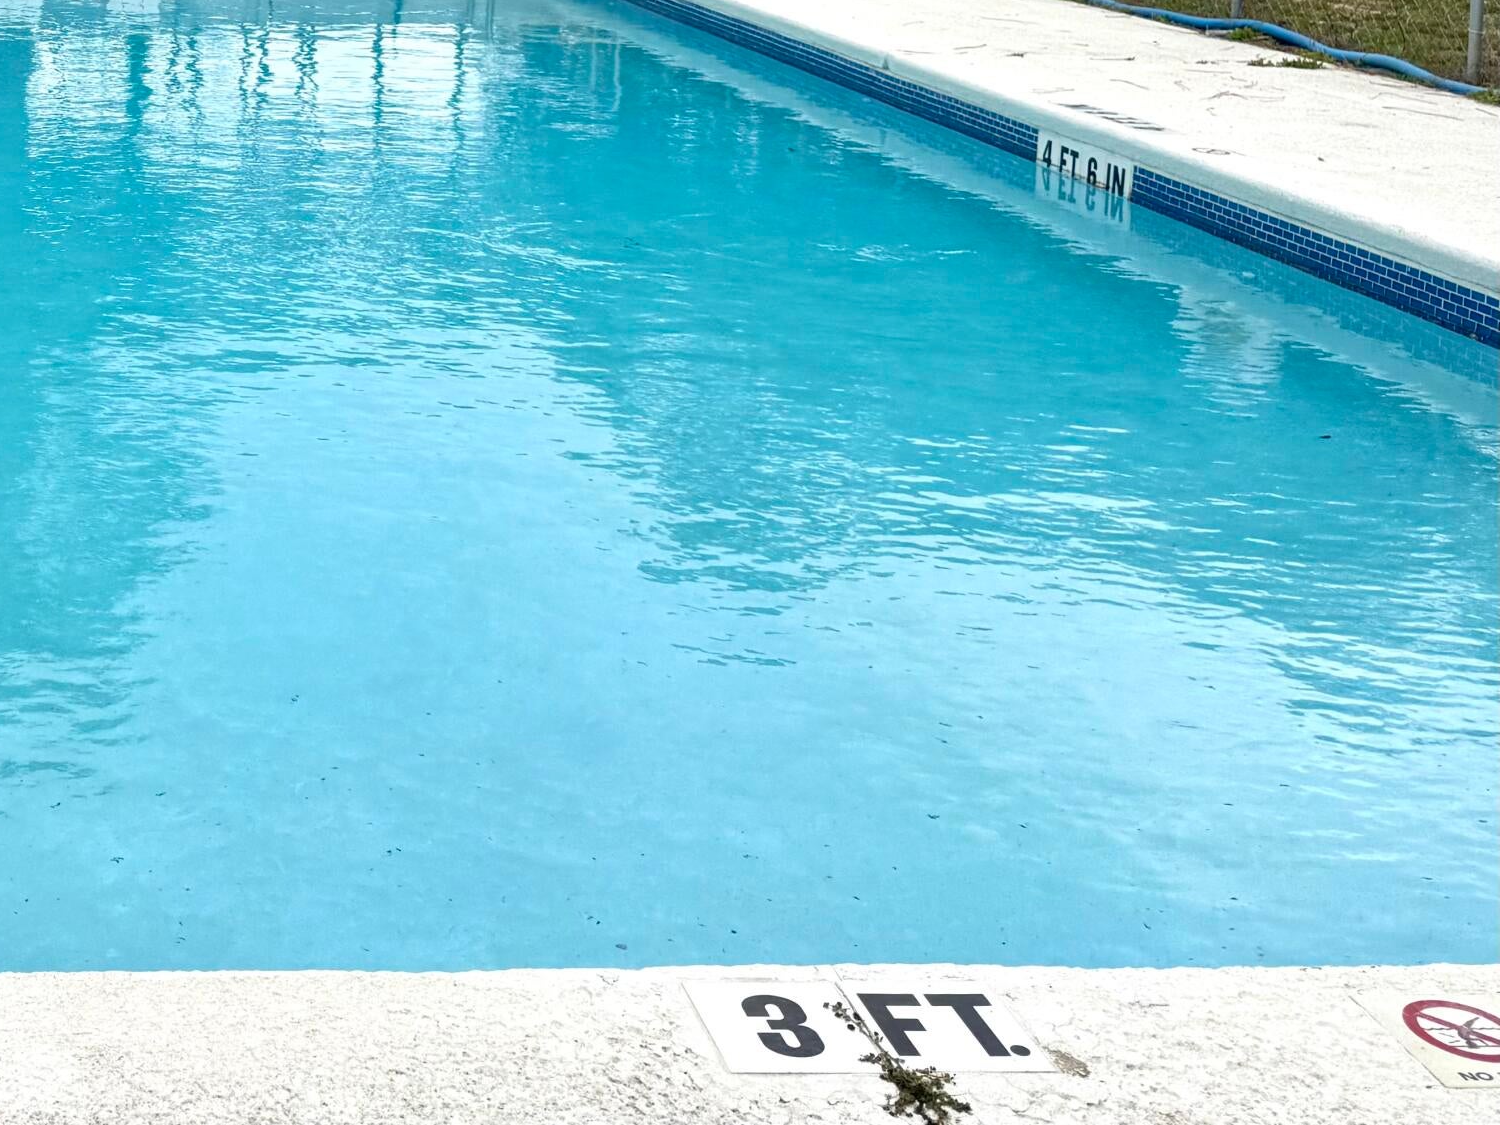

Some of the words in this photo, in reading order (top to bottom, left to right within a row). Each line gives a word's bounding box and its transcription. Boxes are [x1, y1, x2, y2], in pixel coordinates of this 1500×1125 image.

[1043, 140, 1052, 167] 4
[1059, 145, 1079, 178] FT
[1087, 157, 1097, 187] 6
[1106, 163, 1126, 197] IN
[741, 994, 825, 1058] 3
[856, 993, 1031, 1057] FT.
[1457, 1072, 1494, 1081] NO
